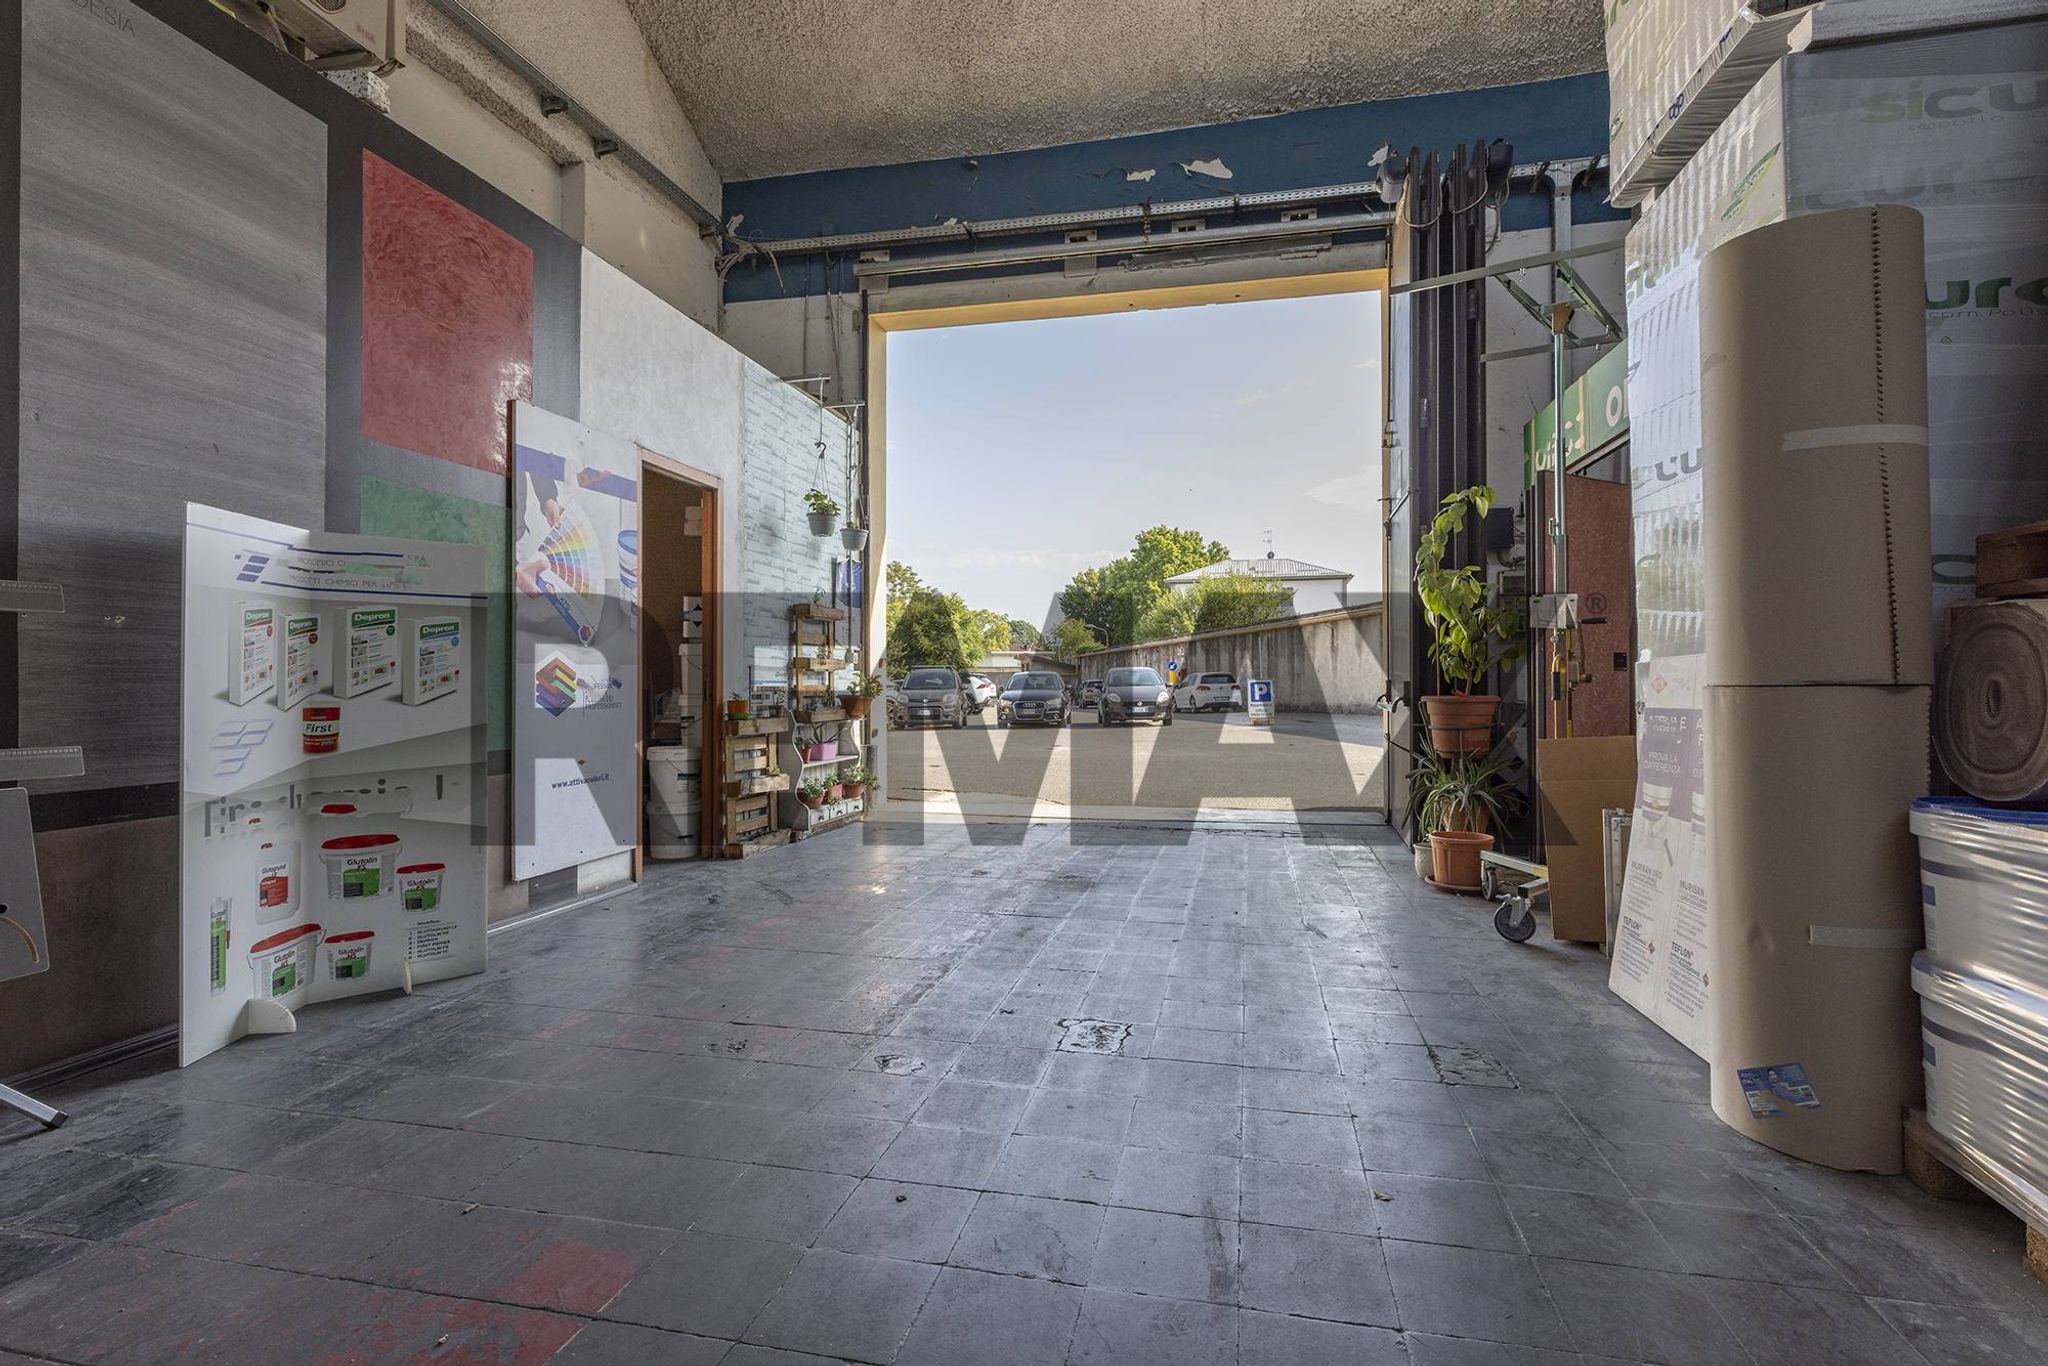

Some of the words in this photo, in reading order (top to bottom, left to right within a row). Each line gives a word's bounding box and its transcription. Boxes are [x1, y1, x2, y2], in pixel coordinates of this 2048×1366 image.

[354, 612, 391, 622] Depron
[422, 625, 455, 635] Depron
[1254, 683, 1268, 701] P
[305, 723, 333, 733] First
[346, 857, 378, 866] Glutolin
[406, 878, 435, 888] Glutolin
